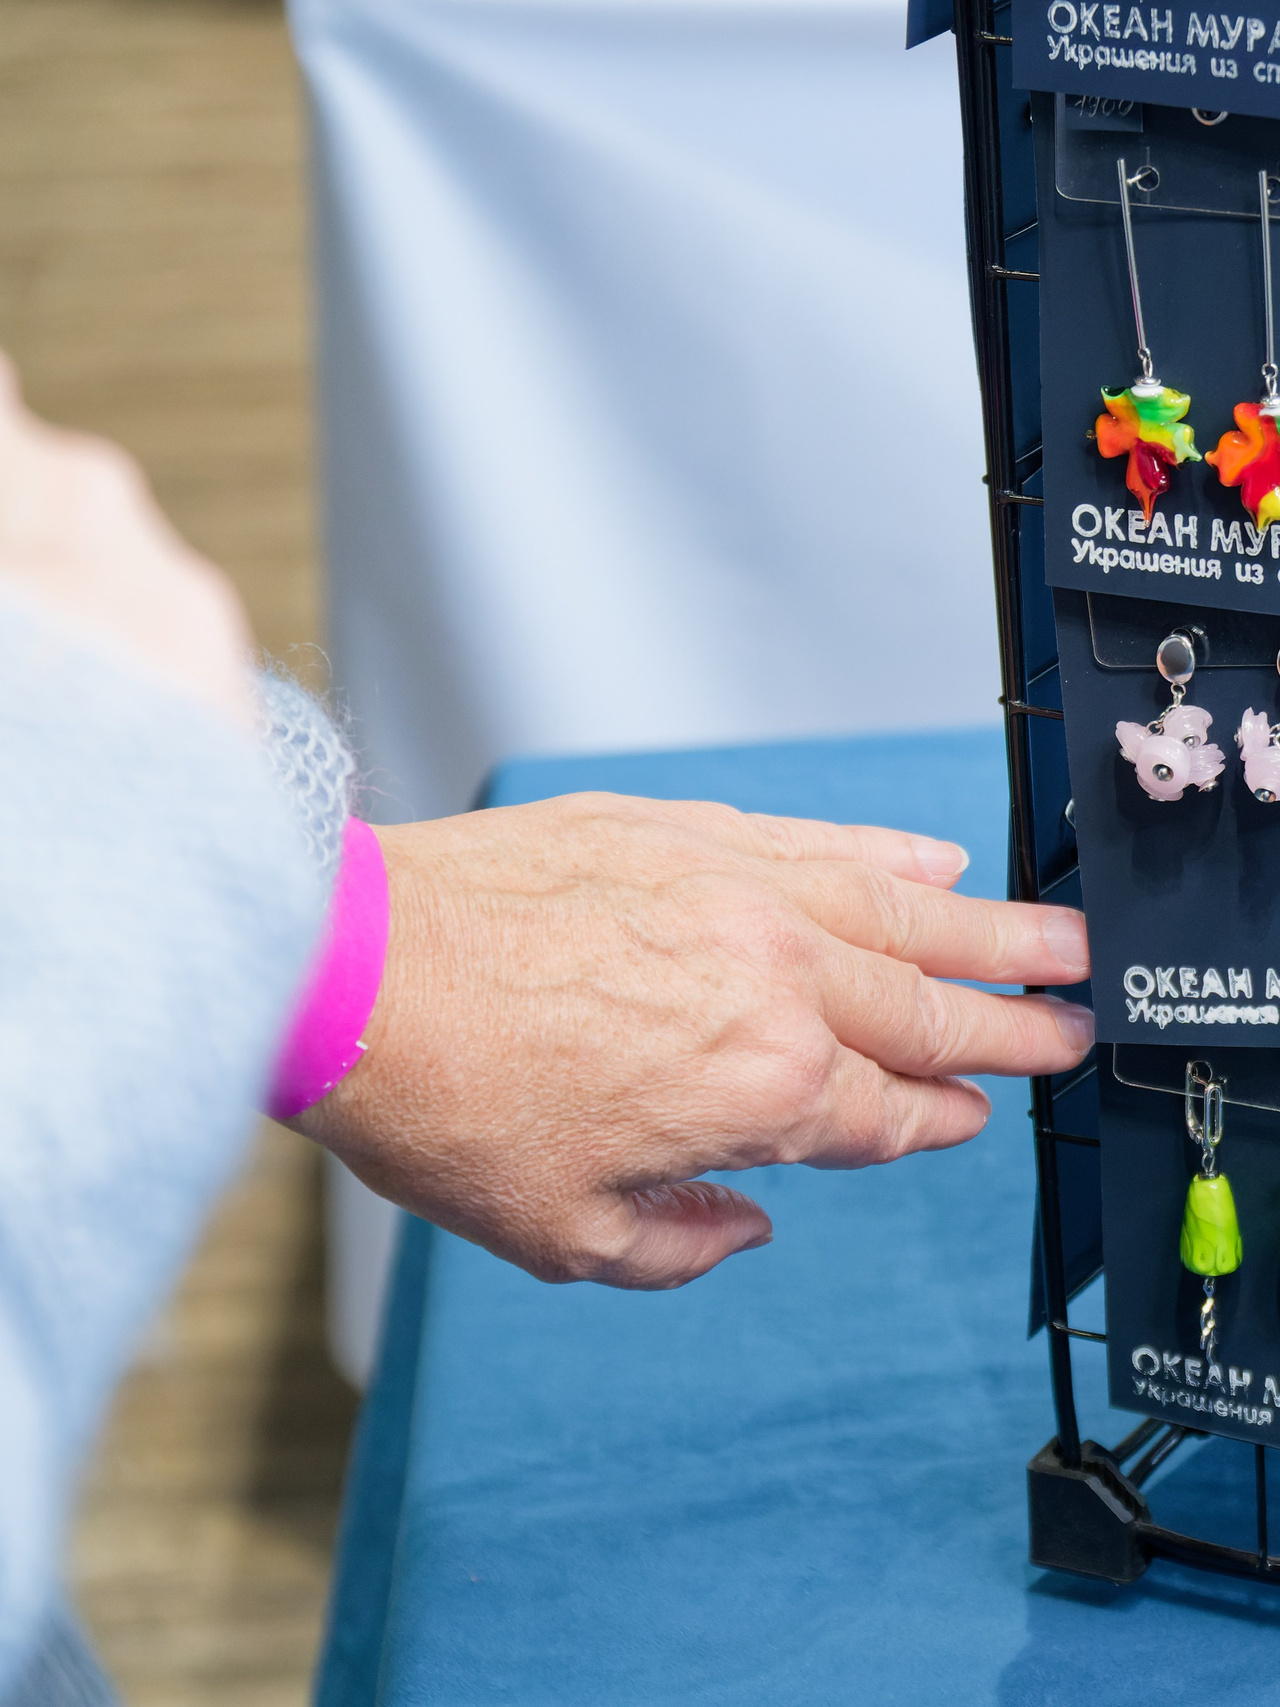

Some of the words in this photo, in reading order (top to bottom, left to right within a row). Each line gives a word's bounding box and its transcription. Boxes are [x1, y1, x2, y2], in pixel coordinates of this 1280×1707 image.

[1047, 0, 1173, 44] ОКЕАН
[1047, 35, 1196, 75] Украшения
[1210, 56, 1238, 79] из
[1071, 503, 1198, 550] ОКЕАН
[1071, 538, 1222, 580] Украшения
[1235, 562, 1264, 585] из
[1123, 966, 1251, 999] ОКЕАН
[1131, 1347, 1251, 1396] ОКЕАН
